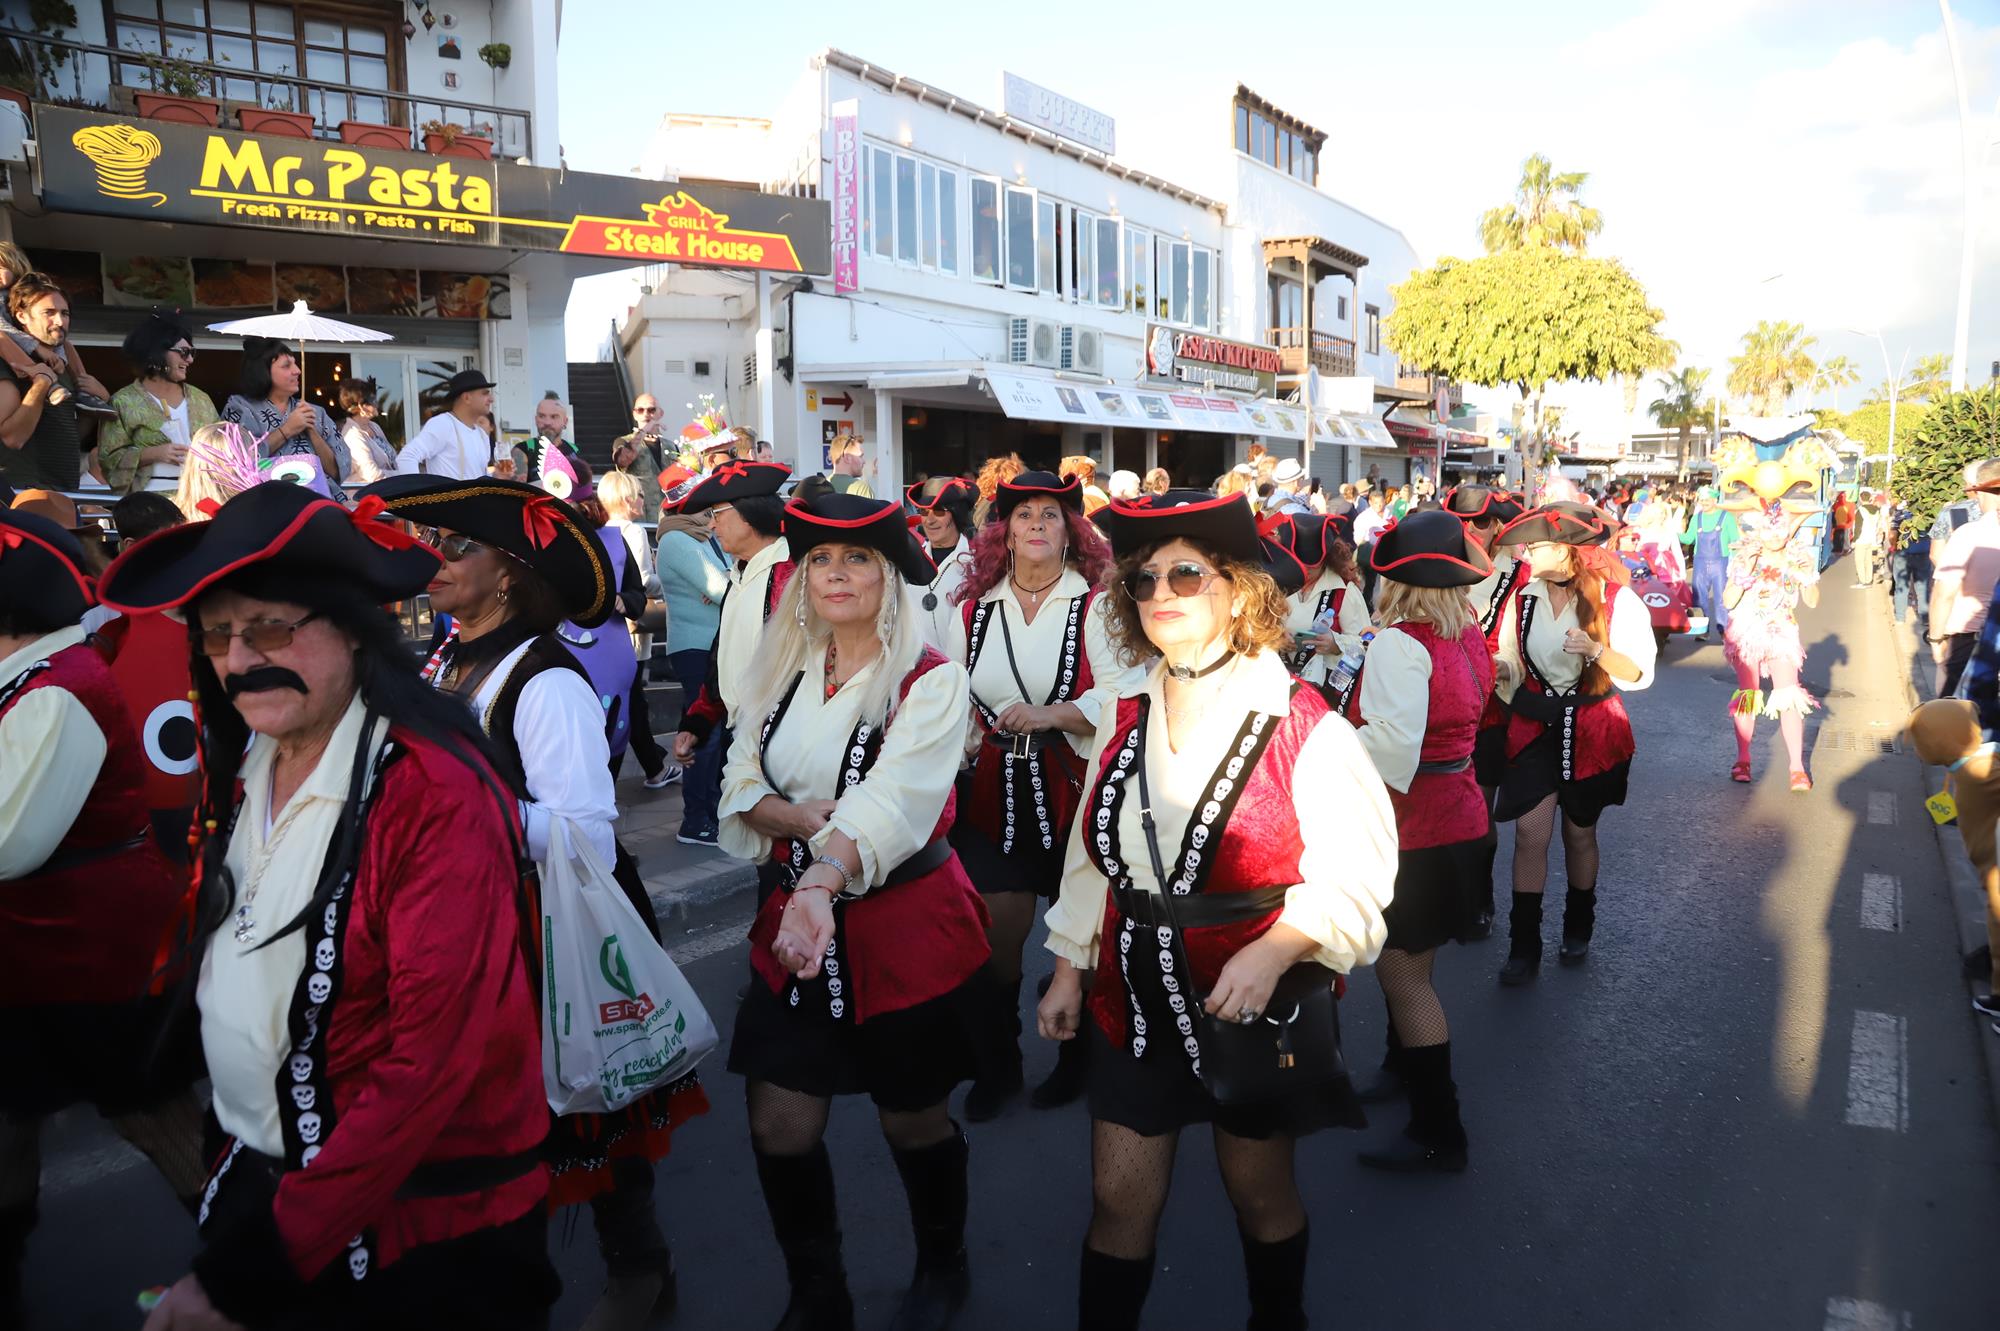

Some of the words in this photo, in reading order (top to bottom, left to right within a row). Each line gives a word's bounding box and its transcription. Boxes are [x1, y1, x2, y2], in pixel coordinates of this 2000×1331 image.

[200, 135, 314, 196] Mr.
[323, 148, 492, 214] Pasta
[836, 131, 856, 265] BUFFET
[222, 199, 281, 218] Fresh
[286, 204, 340, 223] Pizza
[364, 211, 416, 230] Pasta
[438, 217, 476, 234] Fish
[667, 215, 709, 232] GRILL
[604, 226, 681, 256] Steak
[687, 231, 765, 263] House
[1176, 333, 1227, 363] ASIAN
[1227, 343, 1281, 373] KITCHEN
[1646, 594, 1668, 603] M
[1931, 801, 1951, 815] DOG
